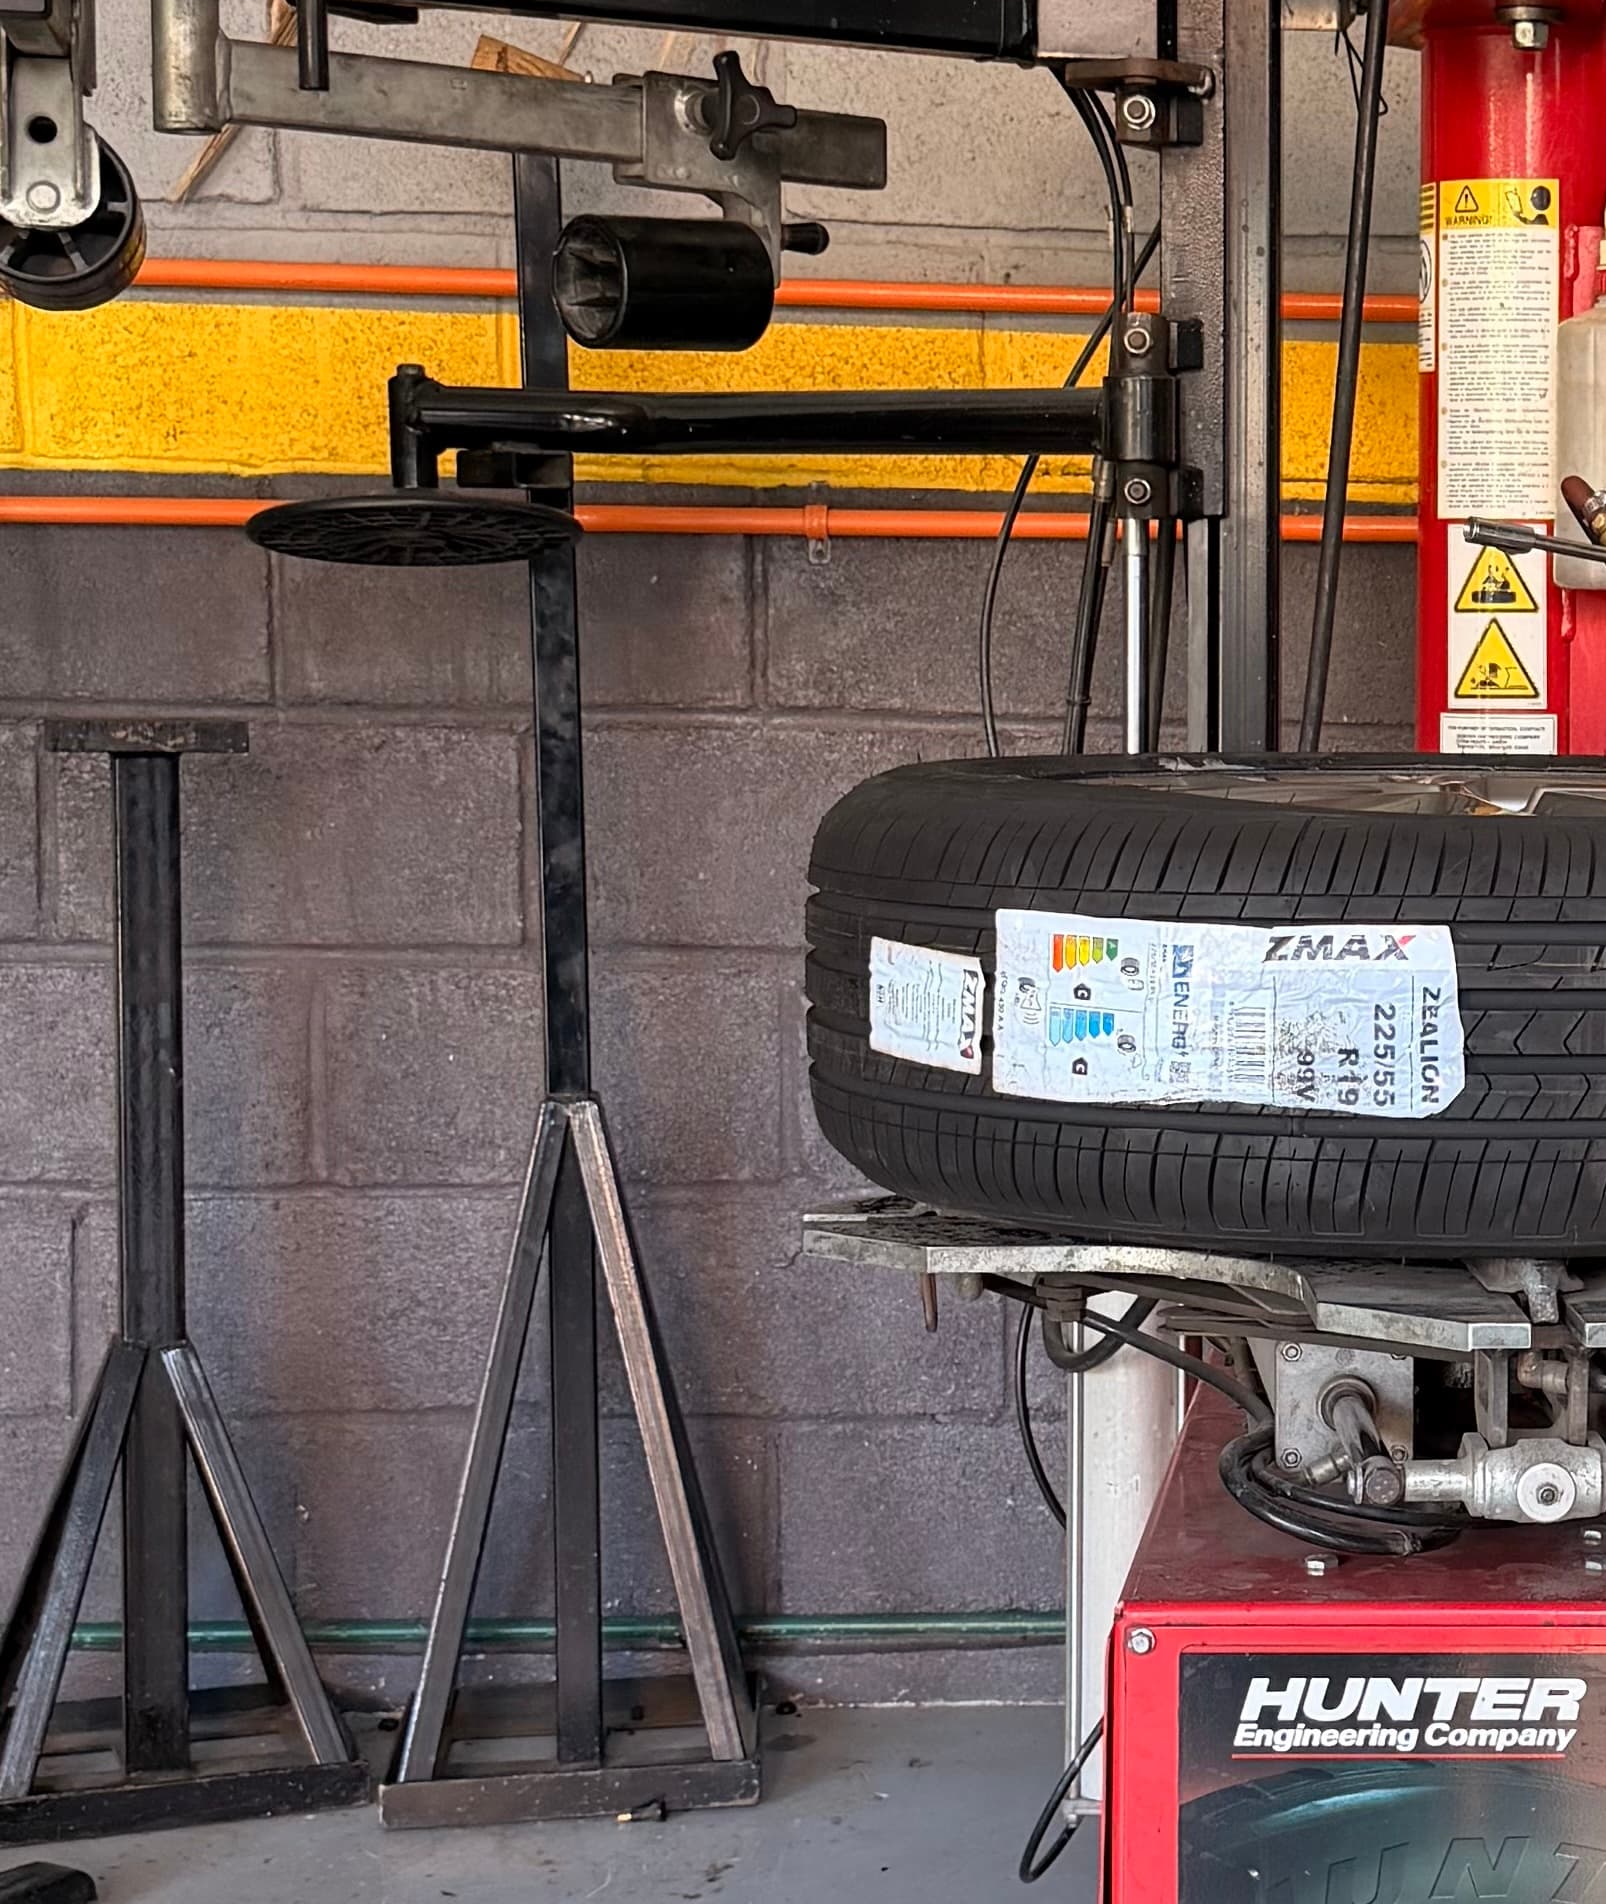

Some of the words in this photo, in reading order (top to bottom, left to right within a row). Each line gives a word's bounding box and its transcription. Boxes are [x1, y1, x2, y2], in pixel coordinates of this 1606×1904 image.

[1262, 934, 1417, 963] ZMAX
[1373, 1004, 1396, 1106] 225/55
[1419, 986, 1441, 1103] ZEALION
[1296, 1049, 1316, 1101] 99V
[1239, 1677, 1588, 1721] HUNTER
[1234, 1723, 1419, 1751] Engineering
[1424, 1723, 1577, 1751] Company
